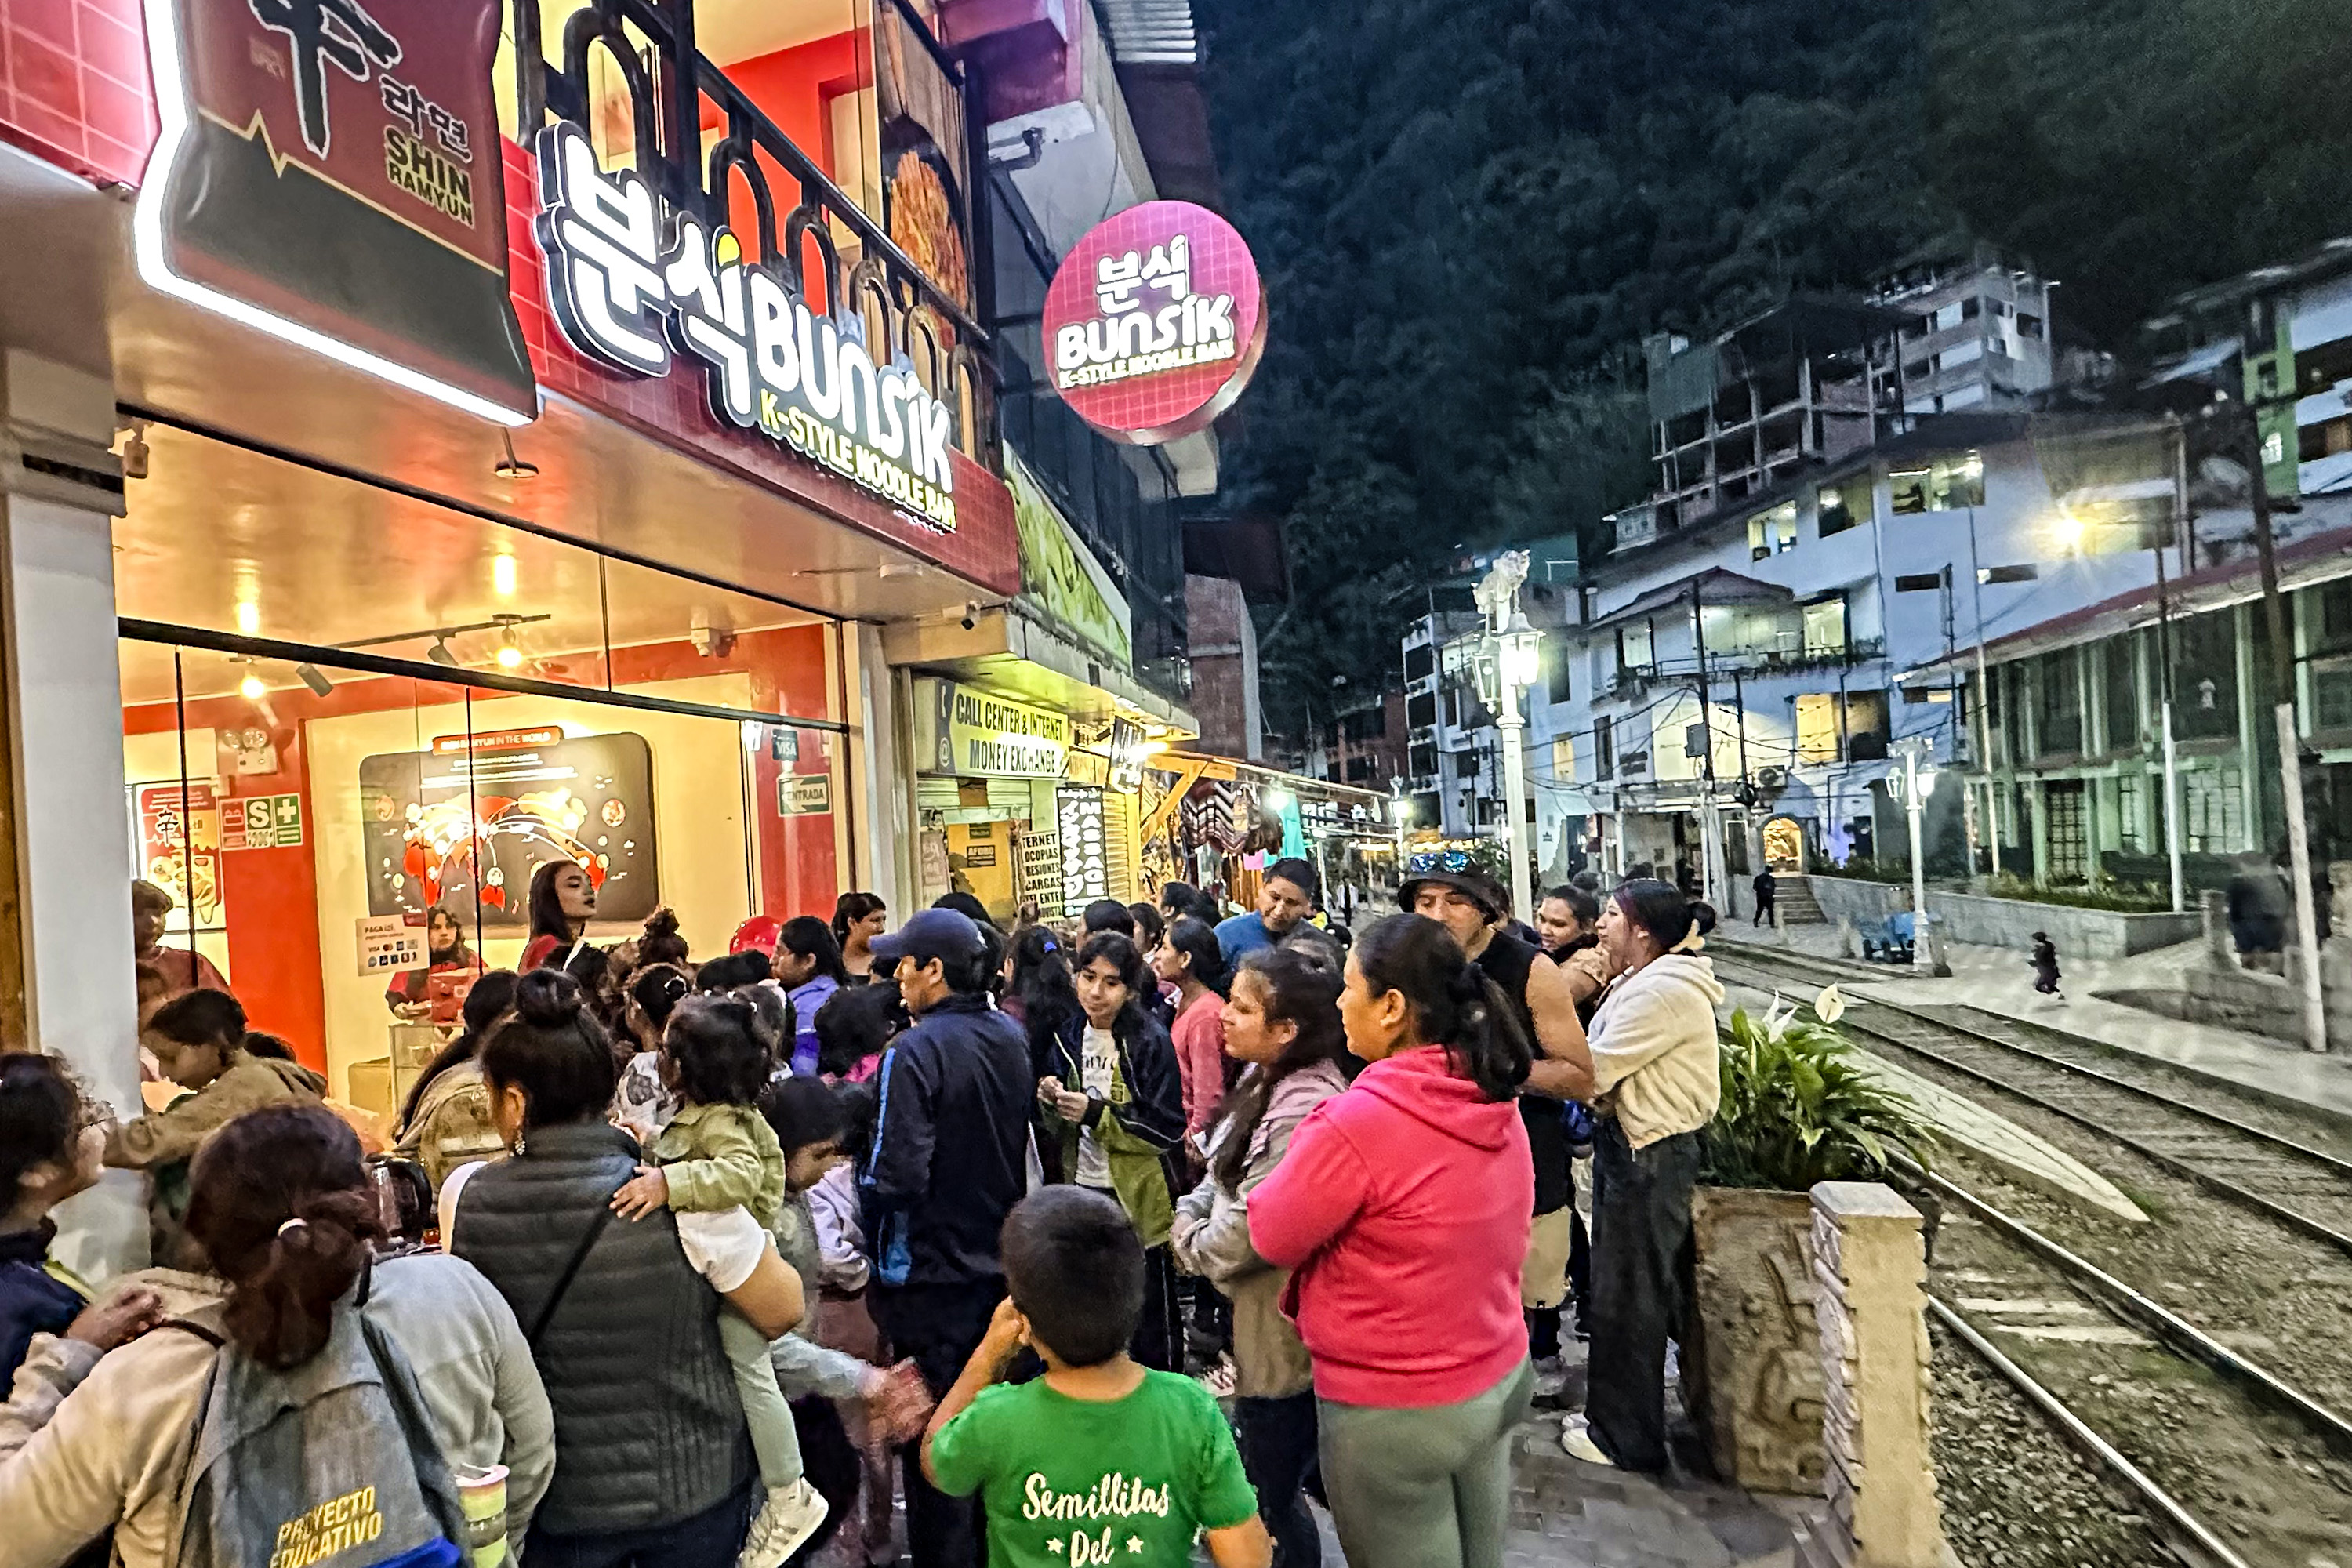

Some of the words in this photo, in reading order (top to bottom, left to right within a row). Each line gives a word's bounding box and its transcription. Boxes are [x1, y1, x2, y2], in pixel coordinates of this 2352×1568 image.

[379, 74, 473, 164] 라면
[384, 124, 472, 205] SHIN
[388, 161, 474, 227] RAMYUN
[558, 130, 751, 419] 분식
[1096, 234, 1189, 314] 분식
[1057, 293, 1234, 369] BUNSIK
[750, 271, 953, 494] BUNSIK
[1059, 359, 1127, 389] K-STYLE
[1128, 346, 1195, 376] NOODLE
[760, 388, 855, 473] K-STYLE
[855, 445, 925, 511] NOODLE
[925, 486, 956, 529] BAR
[505, 734, 521, 744] THE
[956, 693, 982, 728] CALL
[985, 702, 1020, 735] CENTER
[1022, 714, 1028, 735] &
[1029, 712, 1062, 742] INTERNET
[776, 740, 797, 756] VISA
[969, 739, 1008, 771] MONEY
[1011, 745, 1055, 773] EXCHANGE
[249, 800, 270, 828] S
[786, 788, 826, 801] ENTRADA
[1022, 833, 1057, 848] TERNET
[1025, 848, 1059, 862] OCOPIAS
[1025, 862, 1062, 877] RESIONES
[1025, 877, 1062, 891] CARGAS
[277, 1485, 376, 1548] PROYECTO
[1022, 1472, 1171, 1519] Semillitas
[270, 1512, 383, 1568] EDUCATIVO
[1070, 1526, 1115, 1568] Del
